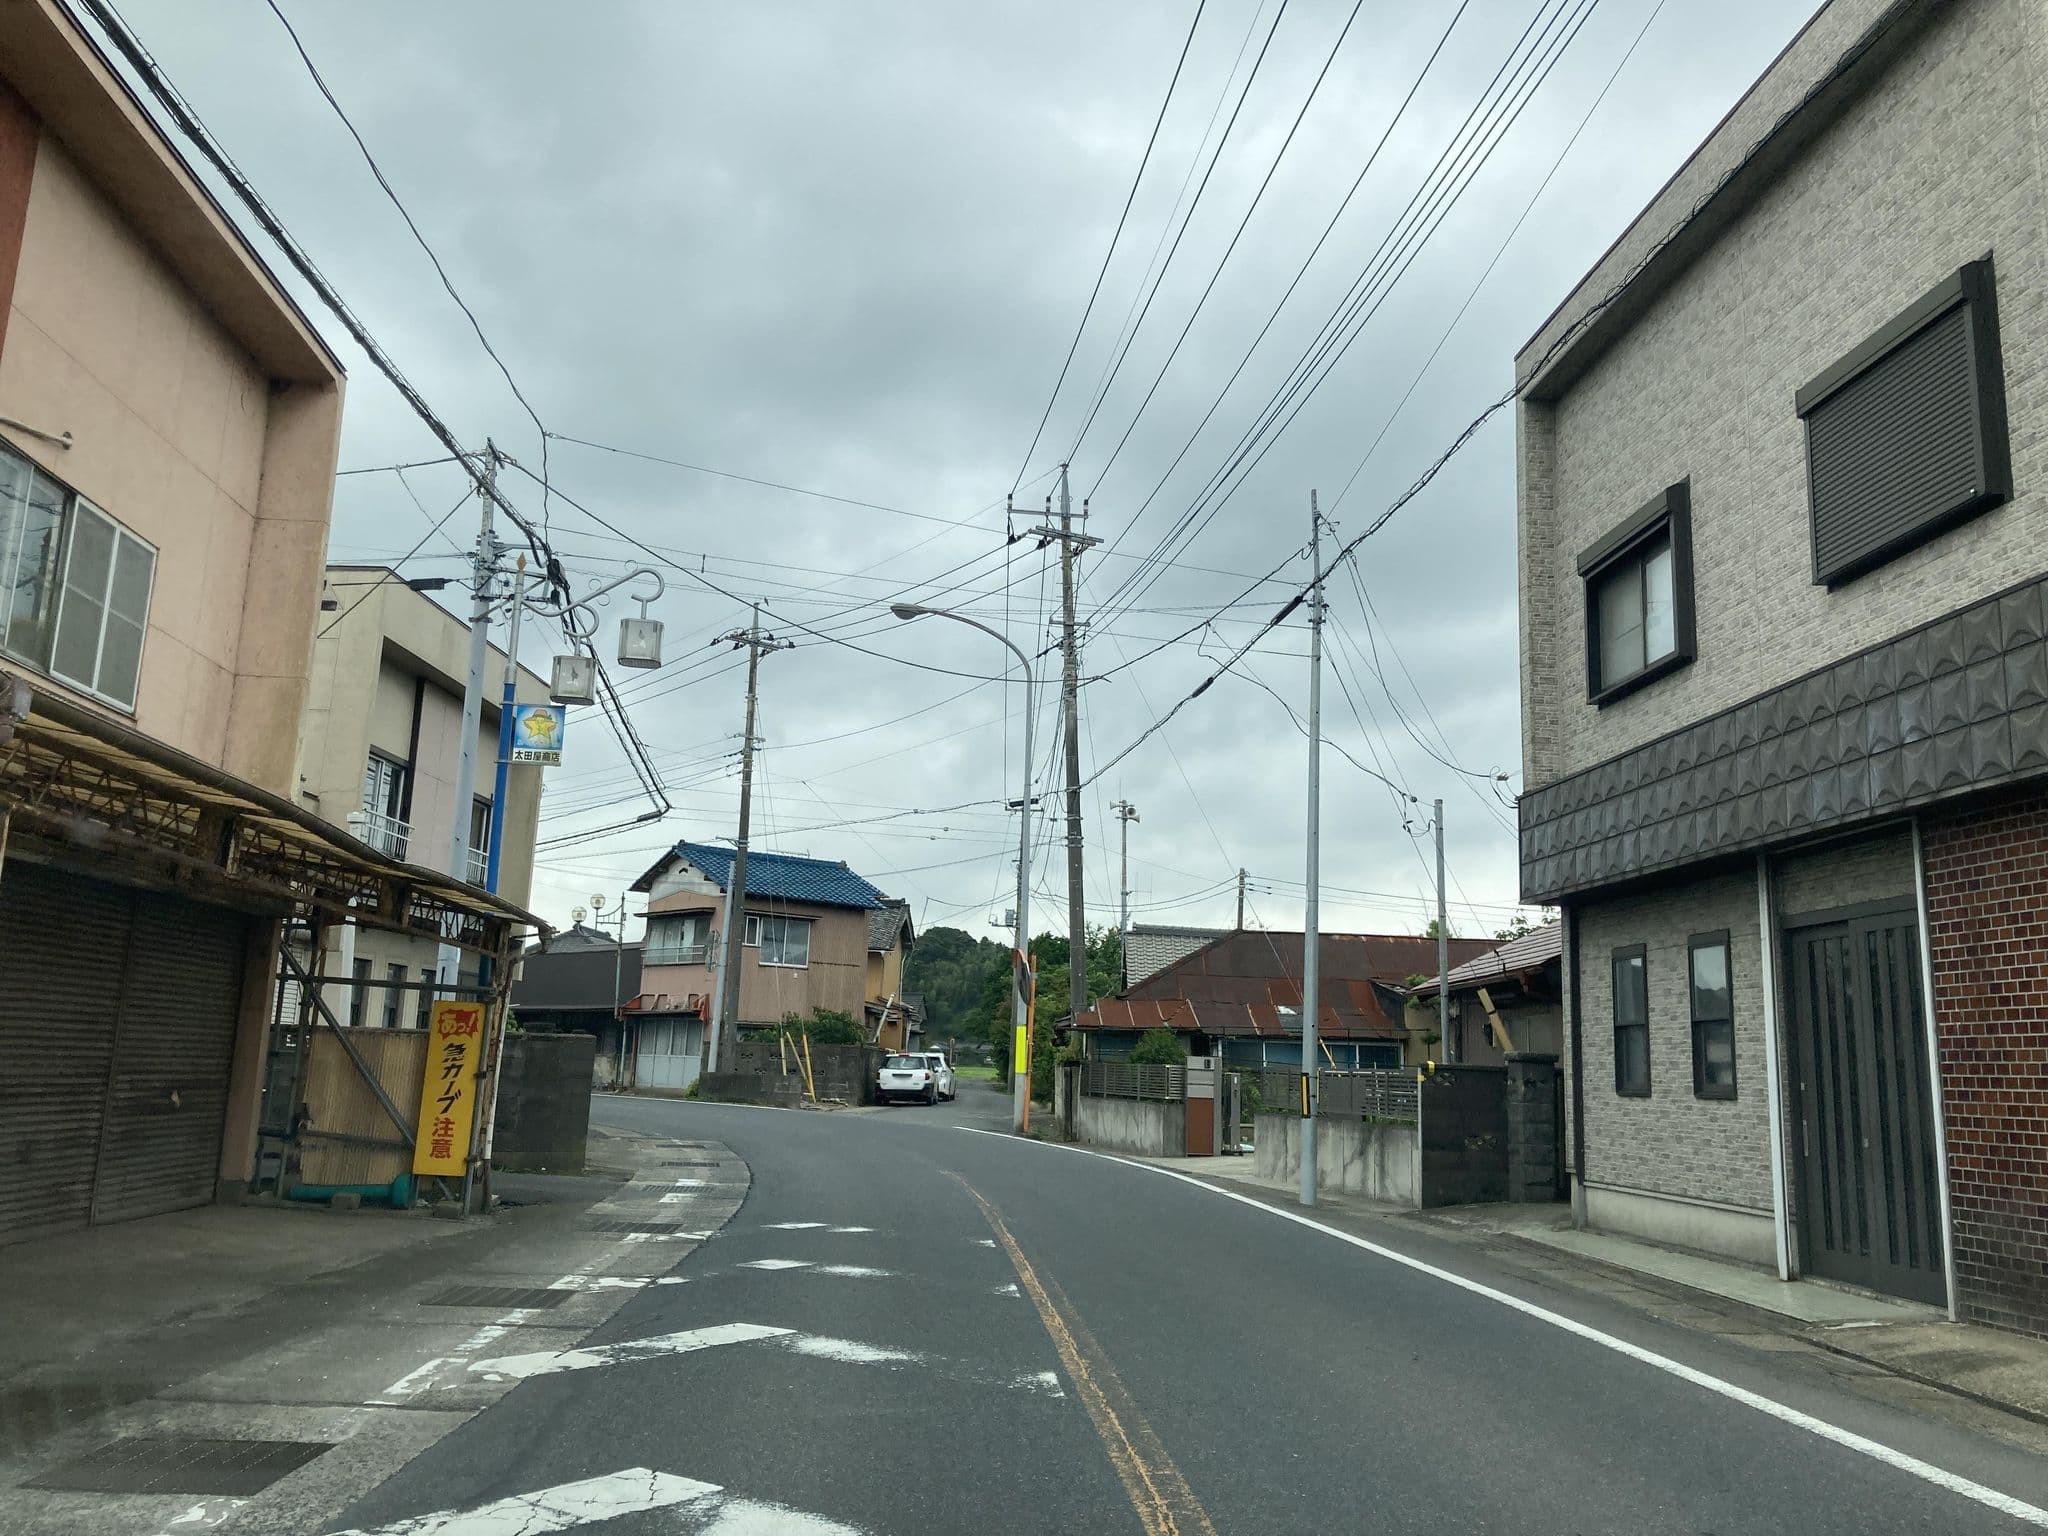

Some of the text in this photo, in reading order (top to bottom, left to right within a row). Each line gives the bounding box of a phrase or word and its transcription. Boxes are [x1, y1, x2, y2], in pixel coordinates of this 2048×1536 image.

[514, 750, 561, 762] 太田屋商店
[430, 1042, 466, 1159] 急カーブ注意
